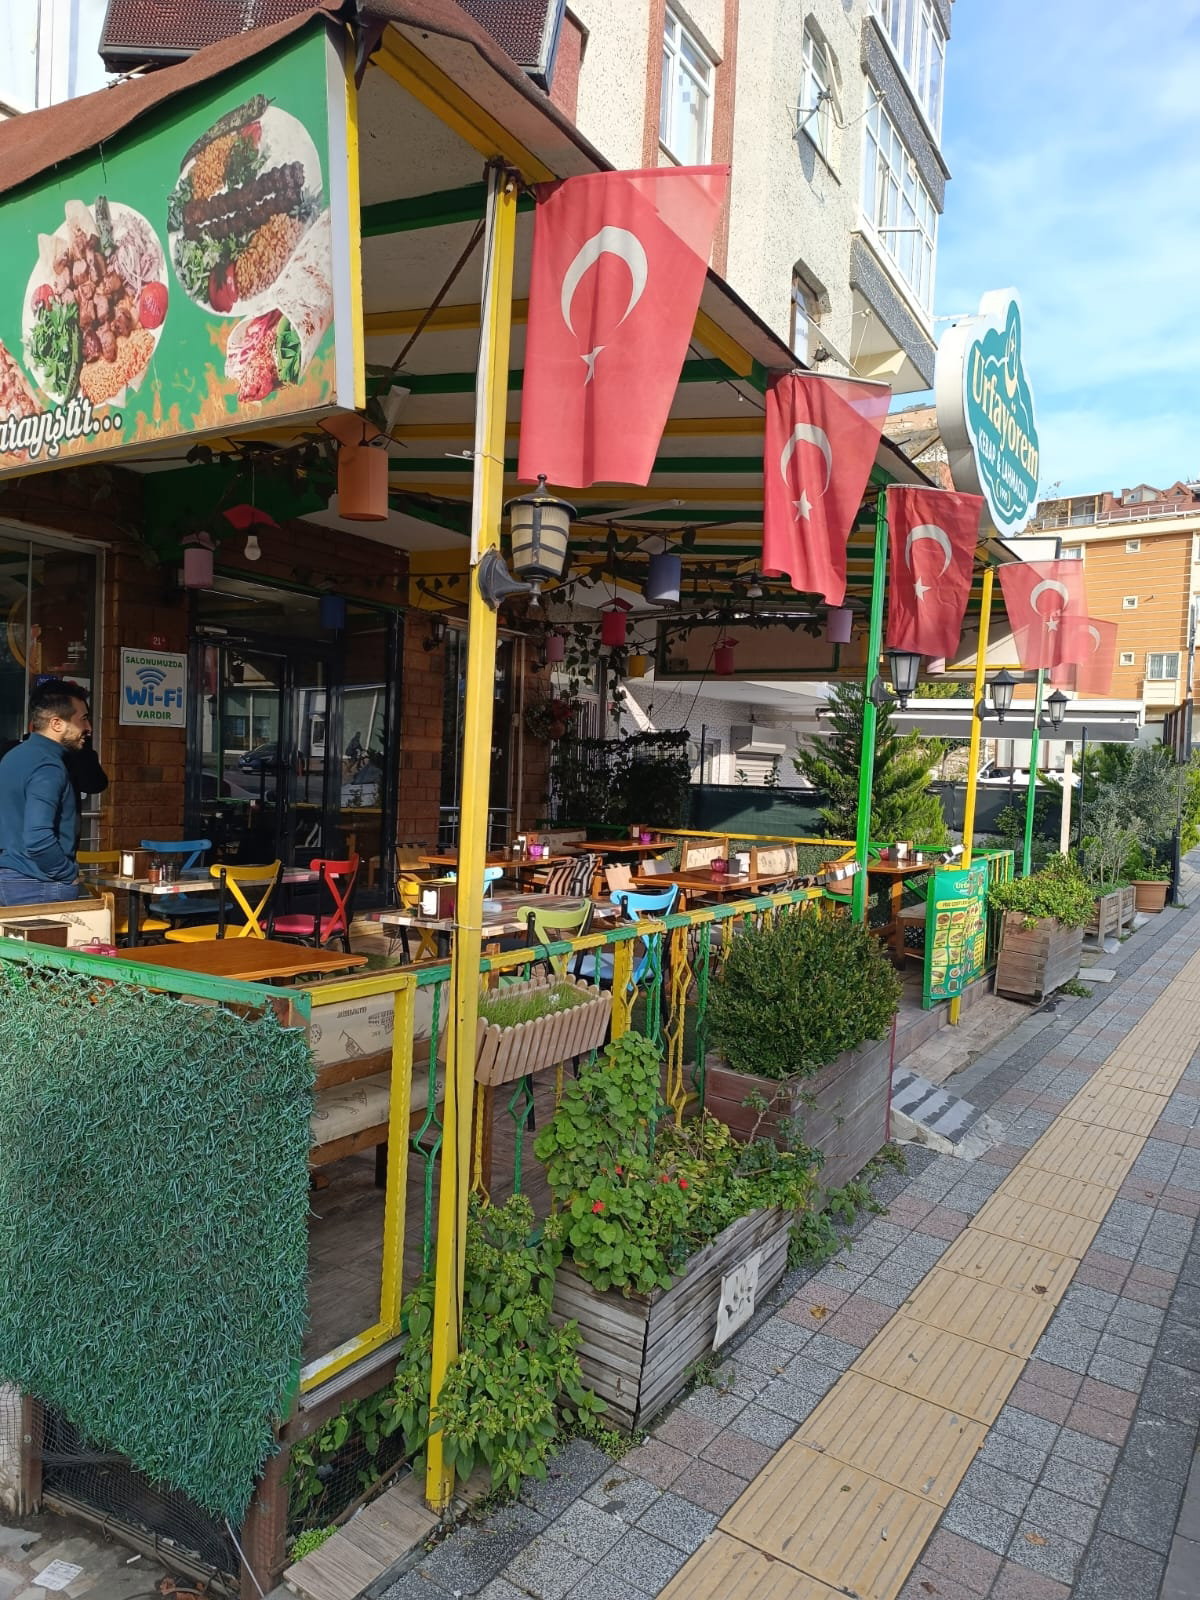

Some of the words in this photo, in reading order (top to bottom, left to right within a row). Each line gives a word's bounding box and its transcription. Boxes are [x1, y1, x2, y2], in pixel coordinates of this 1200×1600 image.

[972, 346, 1038, 482] Urfayörem
[978, 425, 997, 467] KEBAP
[1001, 455, 1029, 507] LAHMACUN
[125, 655, 183, 669] SALONUMUZDA
[125, 685, 183, 709] Wi-Fi
[136, 709, 172, 721] VARDIR
